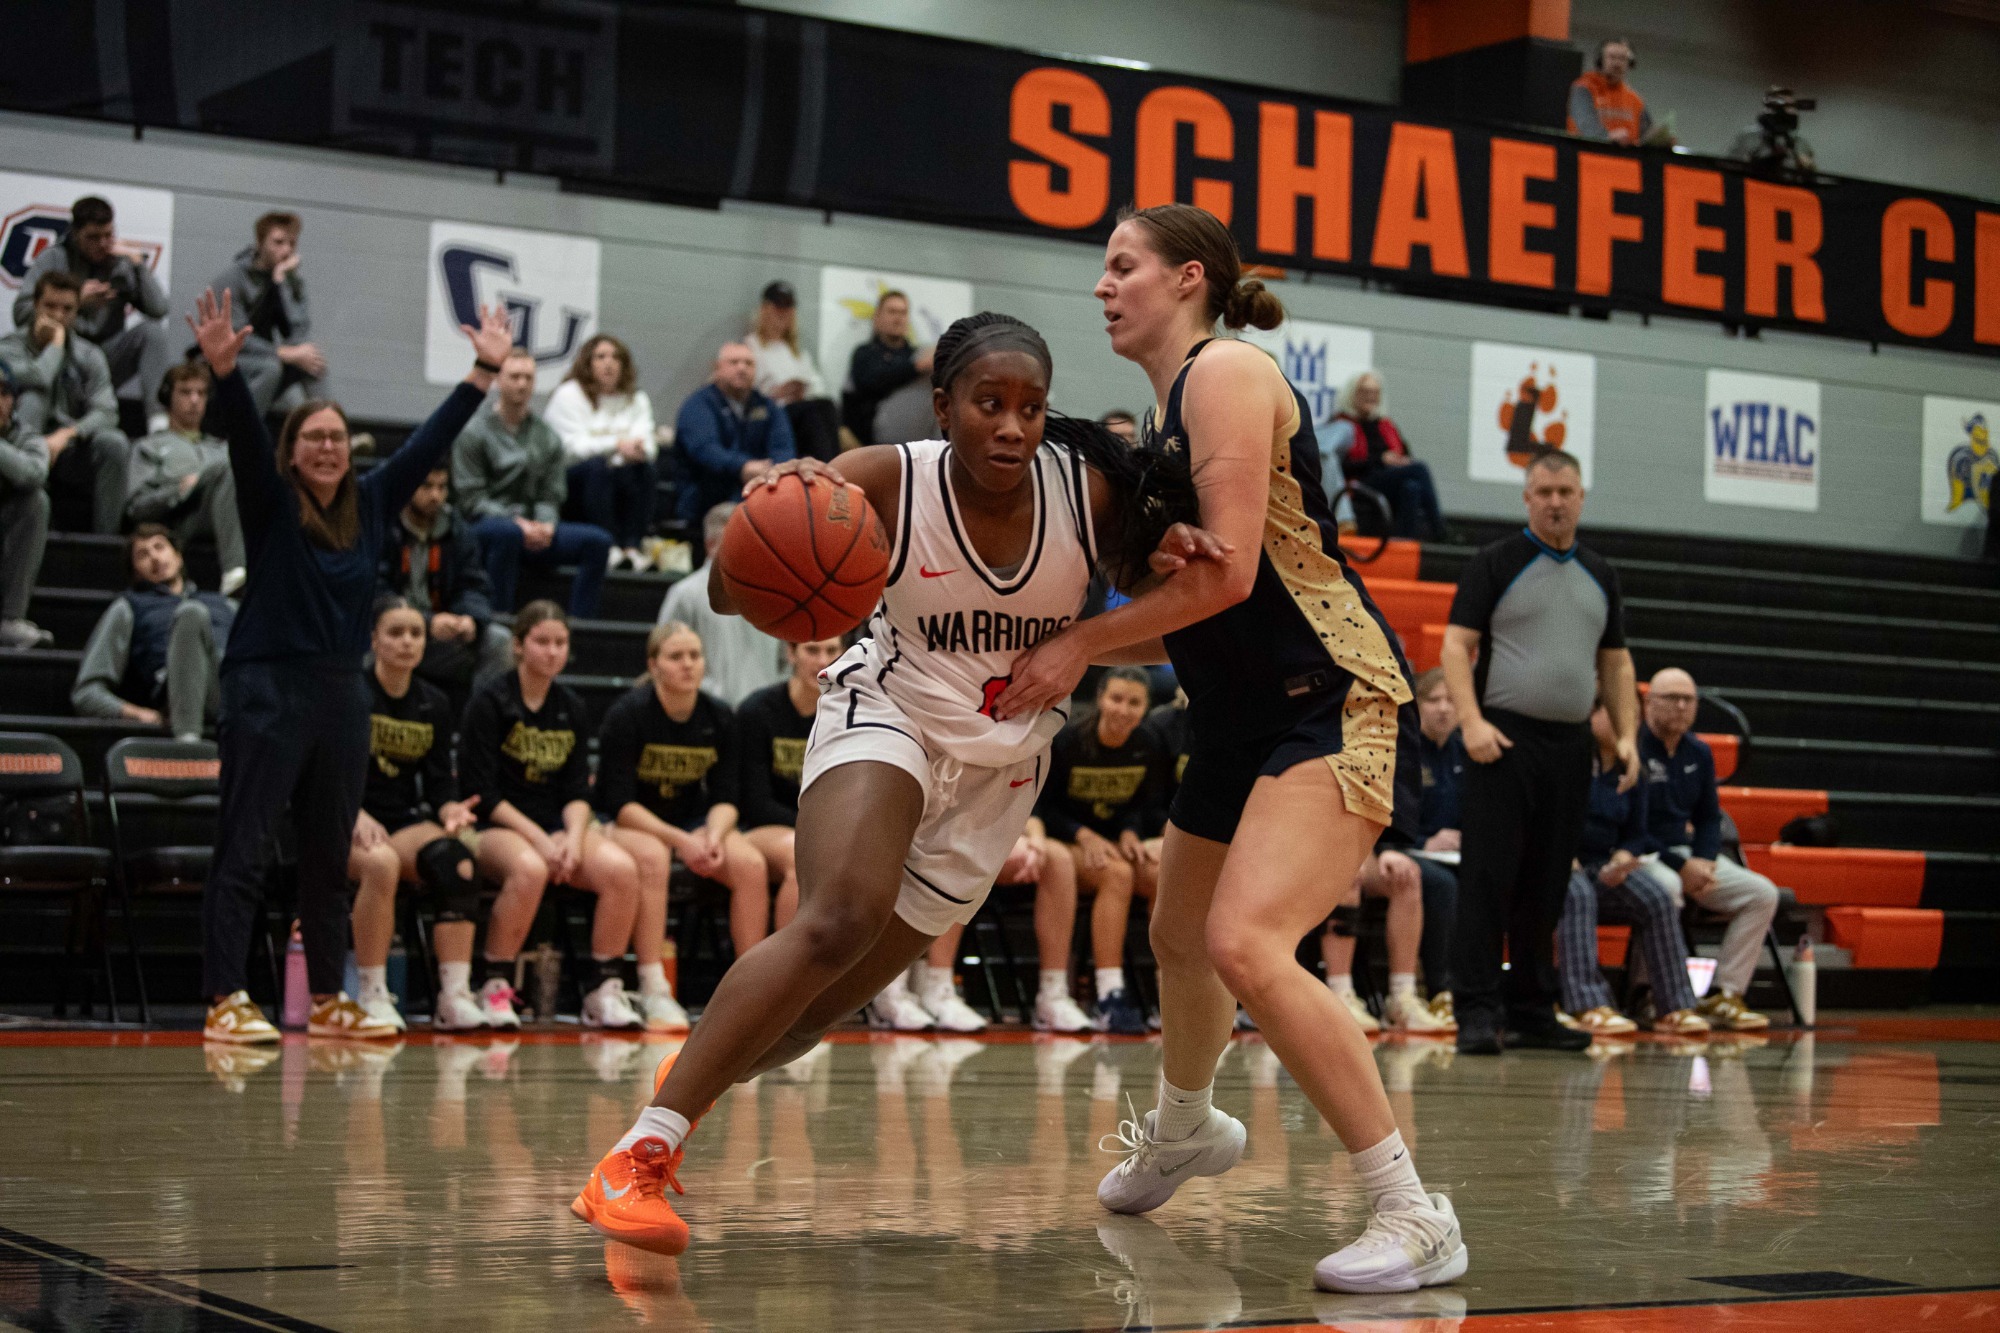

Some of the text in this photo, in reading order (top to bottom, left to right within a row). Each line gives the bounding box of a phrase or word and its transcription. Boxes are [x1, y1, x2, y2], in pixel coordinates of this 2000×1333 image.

[369, 22, 588, 118] TECH
[1009, 68, 1826, 323] SCHAEFER
[1711, 402, 1816, 467] WHAC
